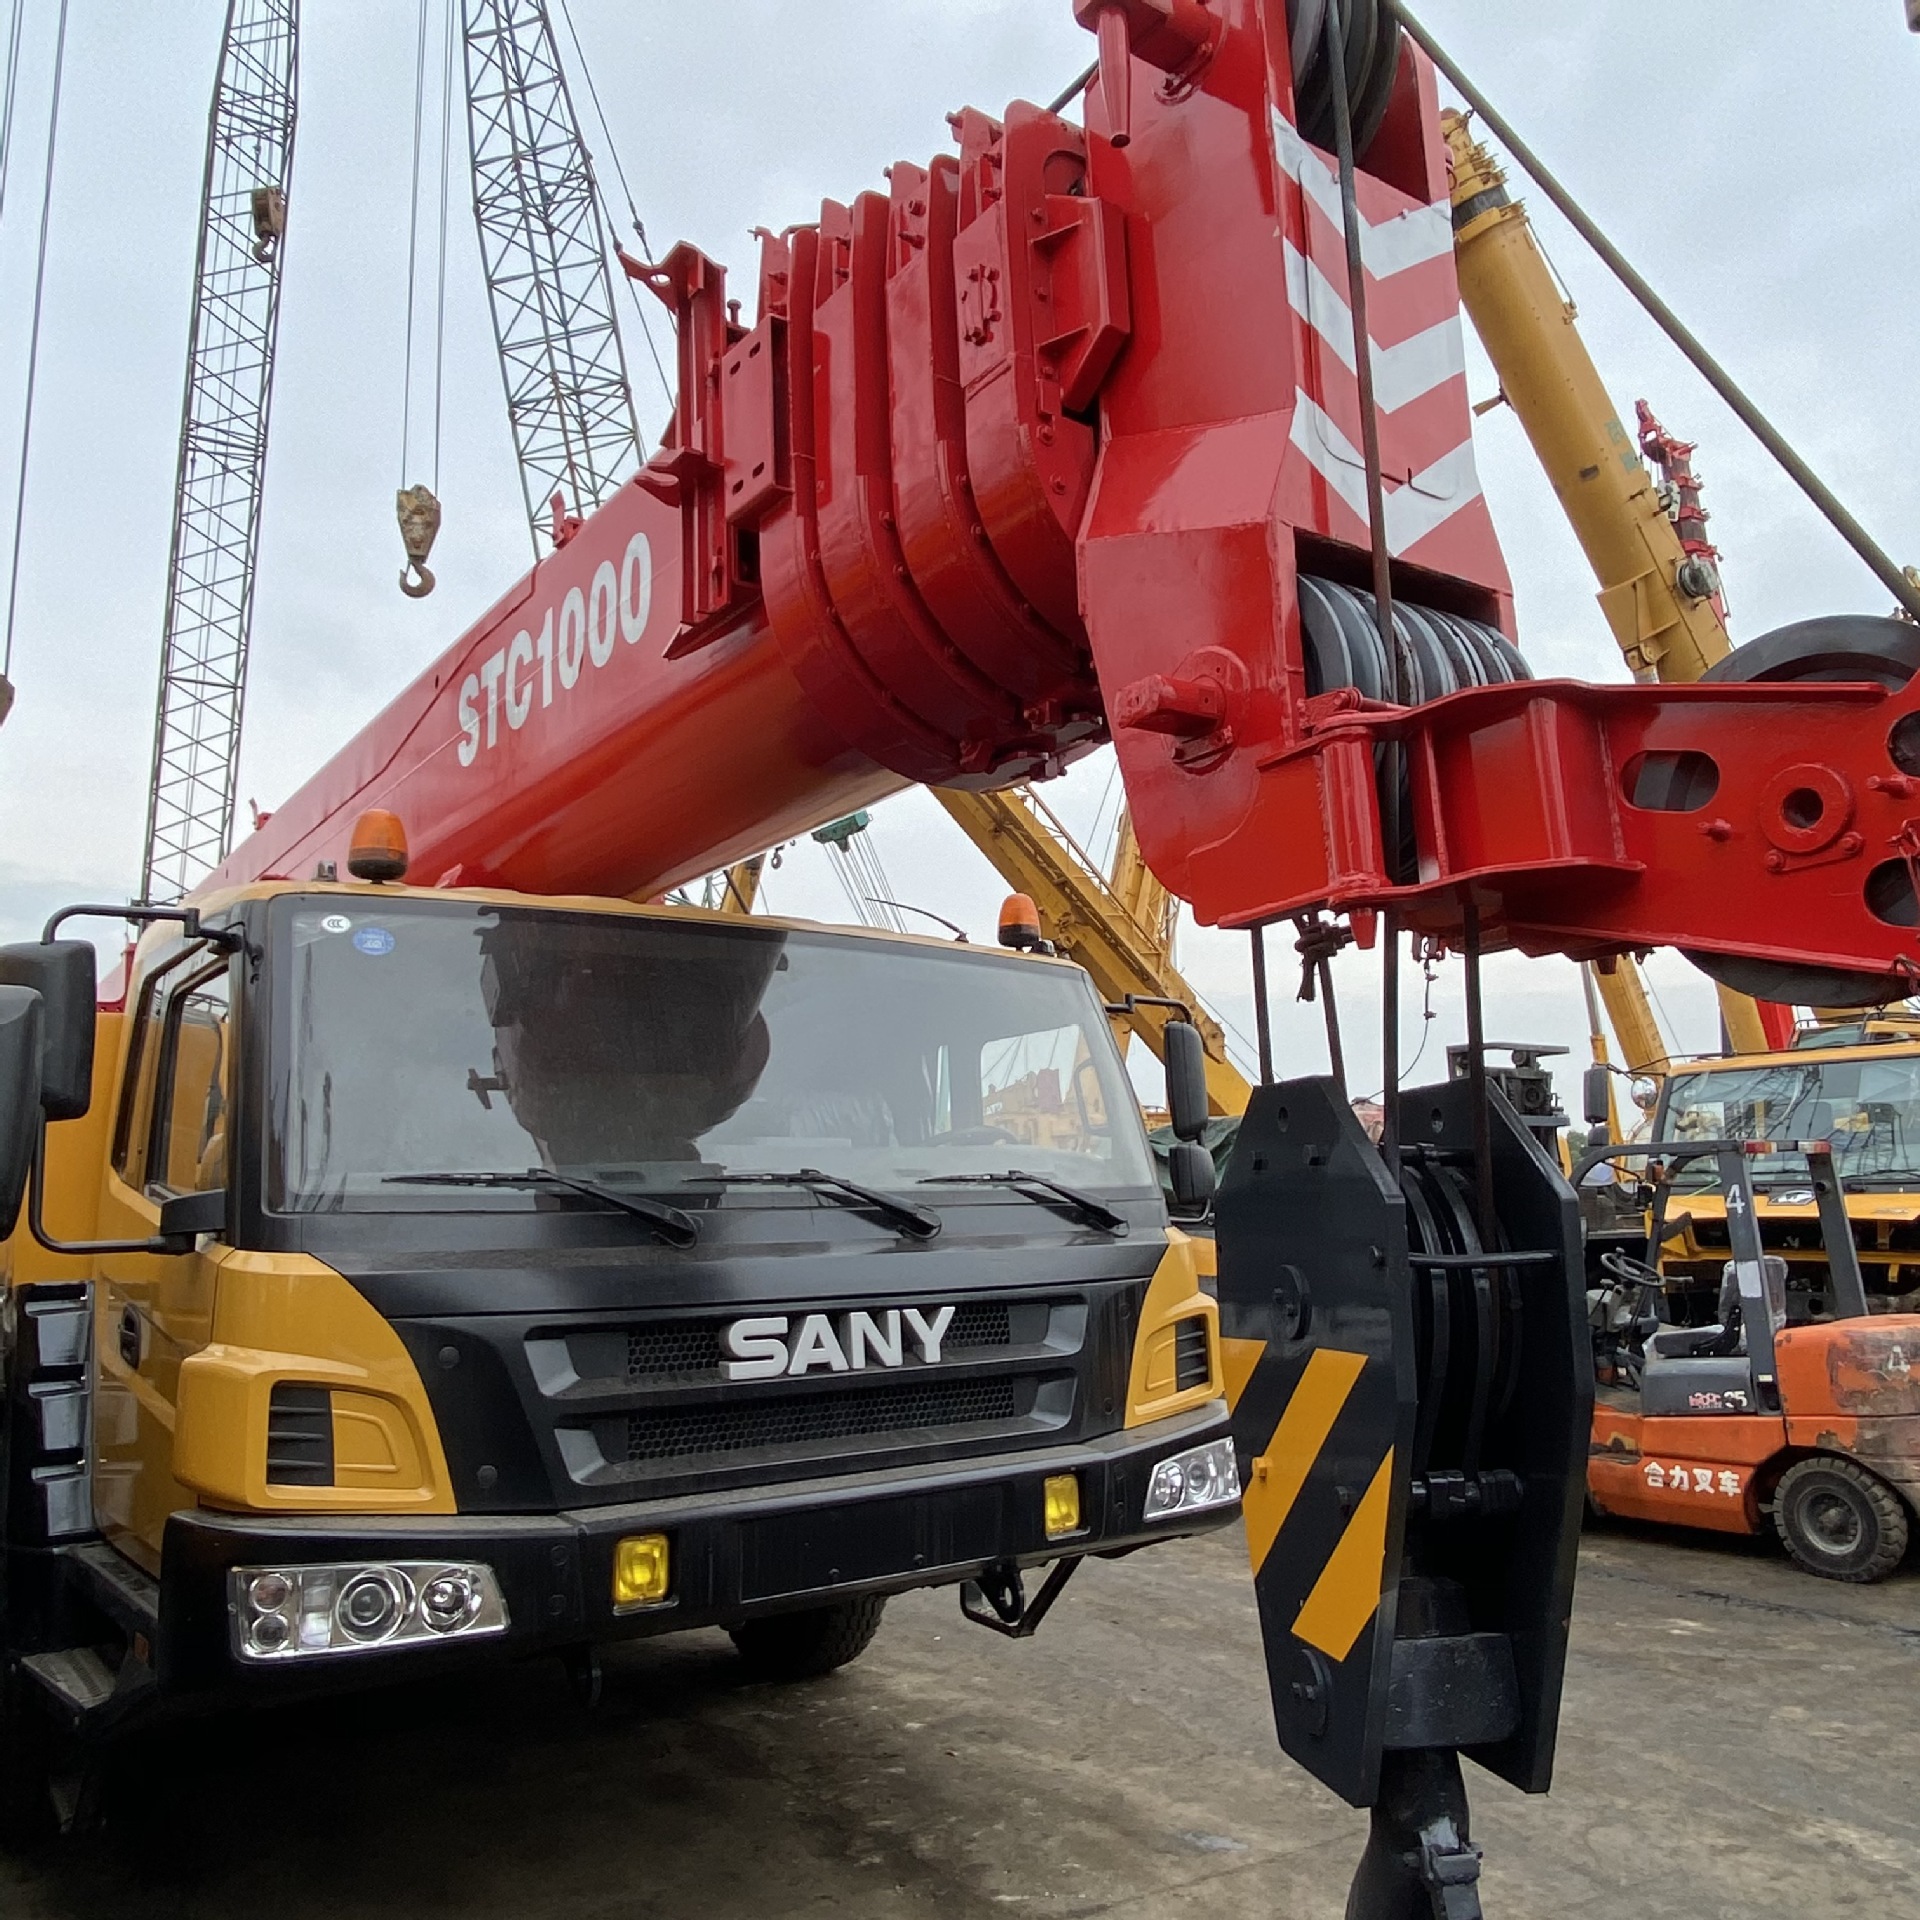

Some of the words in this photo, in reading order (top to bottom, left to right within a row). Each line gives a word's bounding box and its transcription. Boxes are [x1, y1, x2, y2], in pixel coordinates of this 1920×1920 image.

[457, 532, 652, 767] STC1000
[1726, 1184, 1746, 1214] 4
[724, 1306, 956, 1381] SANY
[1643, 1461, 1741, 1497] 合力叉车
